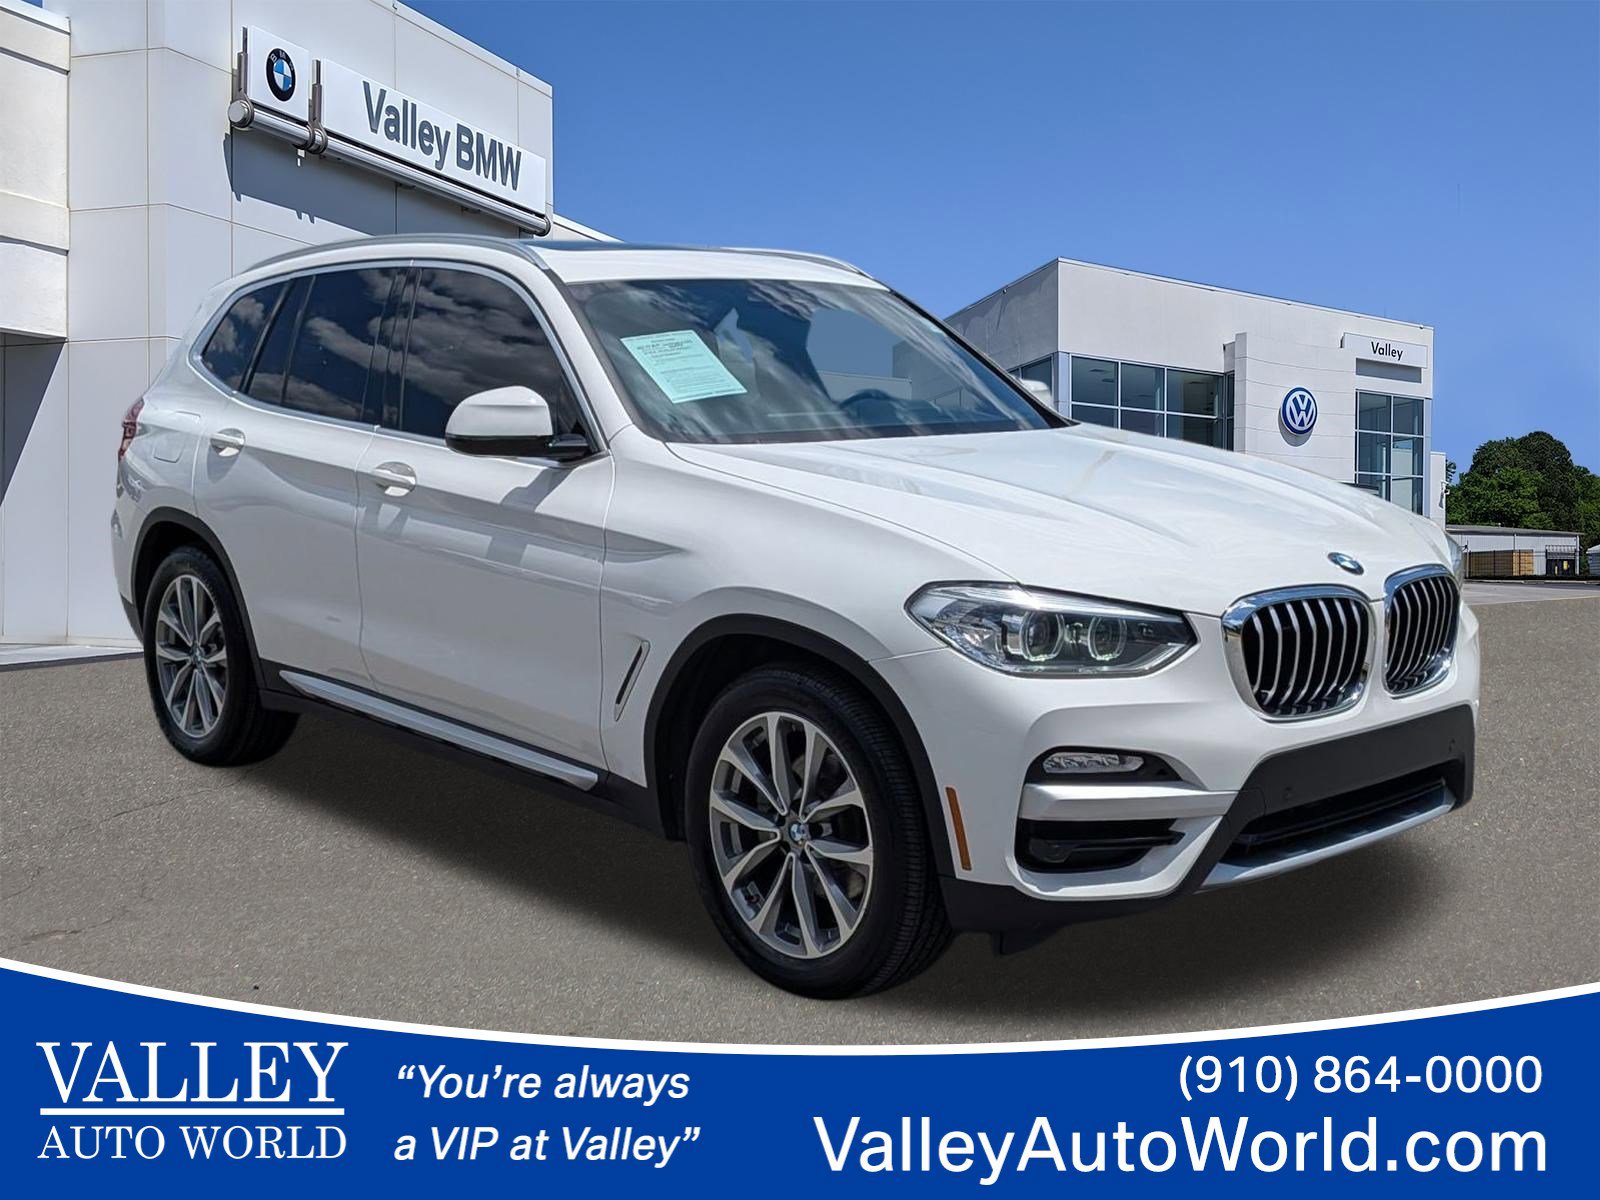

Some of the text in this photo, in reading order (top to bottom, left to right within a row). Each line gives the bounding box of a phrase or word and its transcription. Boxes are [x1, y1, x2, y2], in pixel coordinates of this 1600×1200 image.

[362, 80, 522, 191] Valley BMW
[1371, 341, 1403, 361] Valley
